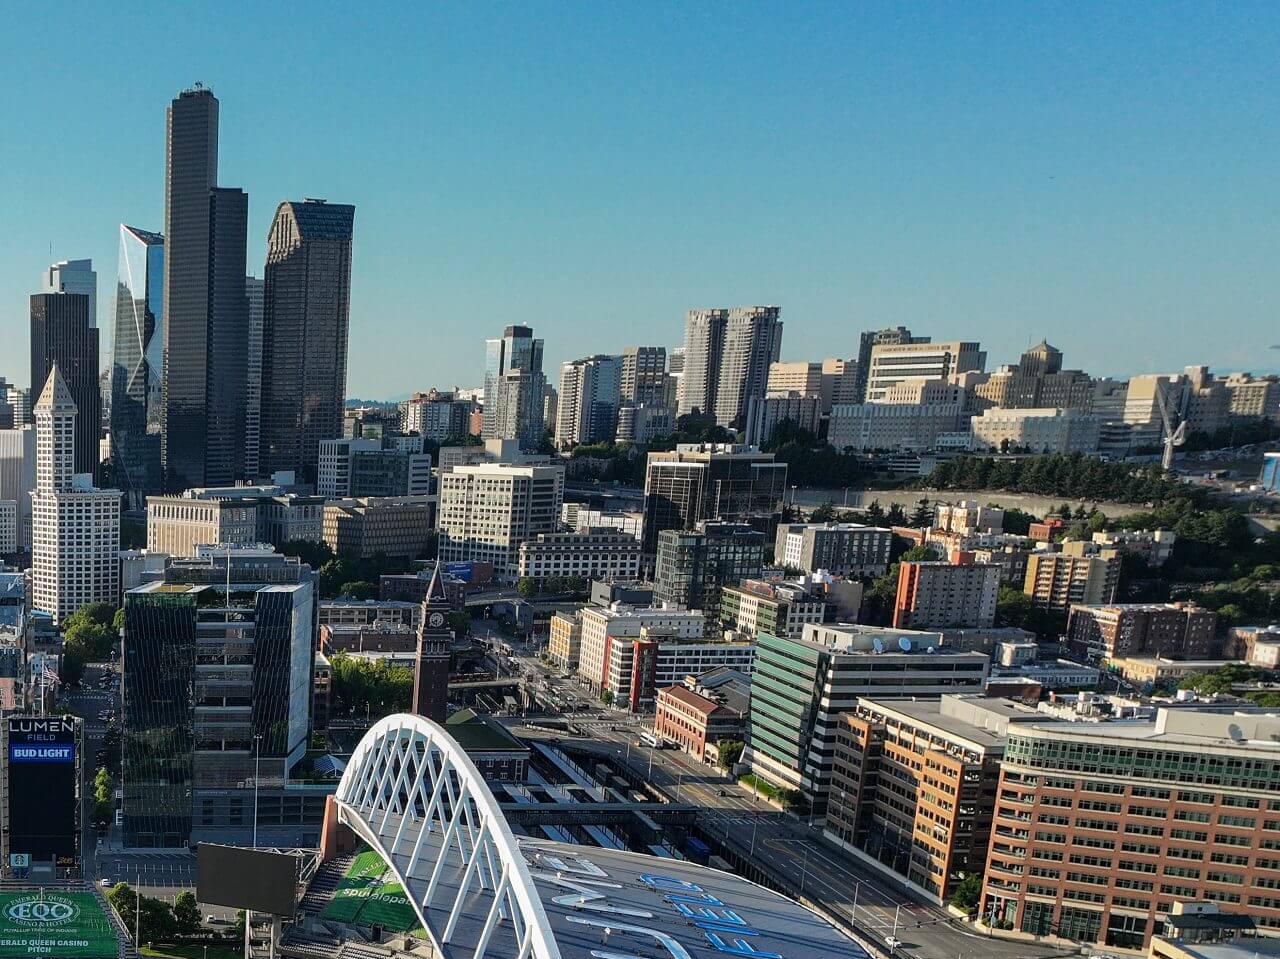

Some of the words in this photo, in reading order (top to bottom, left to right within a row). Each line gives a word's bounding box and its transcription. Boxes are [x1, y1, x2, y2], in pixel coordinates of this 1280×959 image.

[9, 721, 74, 732] LUMEN
[14, 749, 37, 758] BUD
[37, 749, 70, 758] LIGHT
[10, 902, 74, 921] EQC
[638, 872, 784, 959] FIELD
[29, 939, 56, 947] QUEEN
